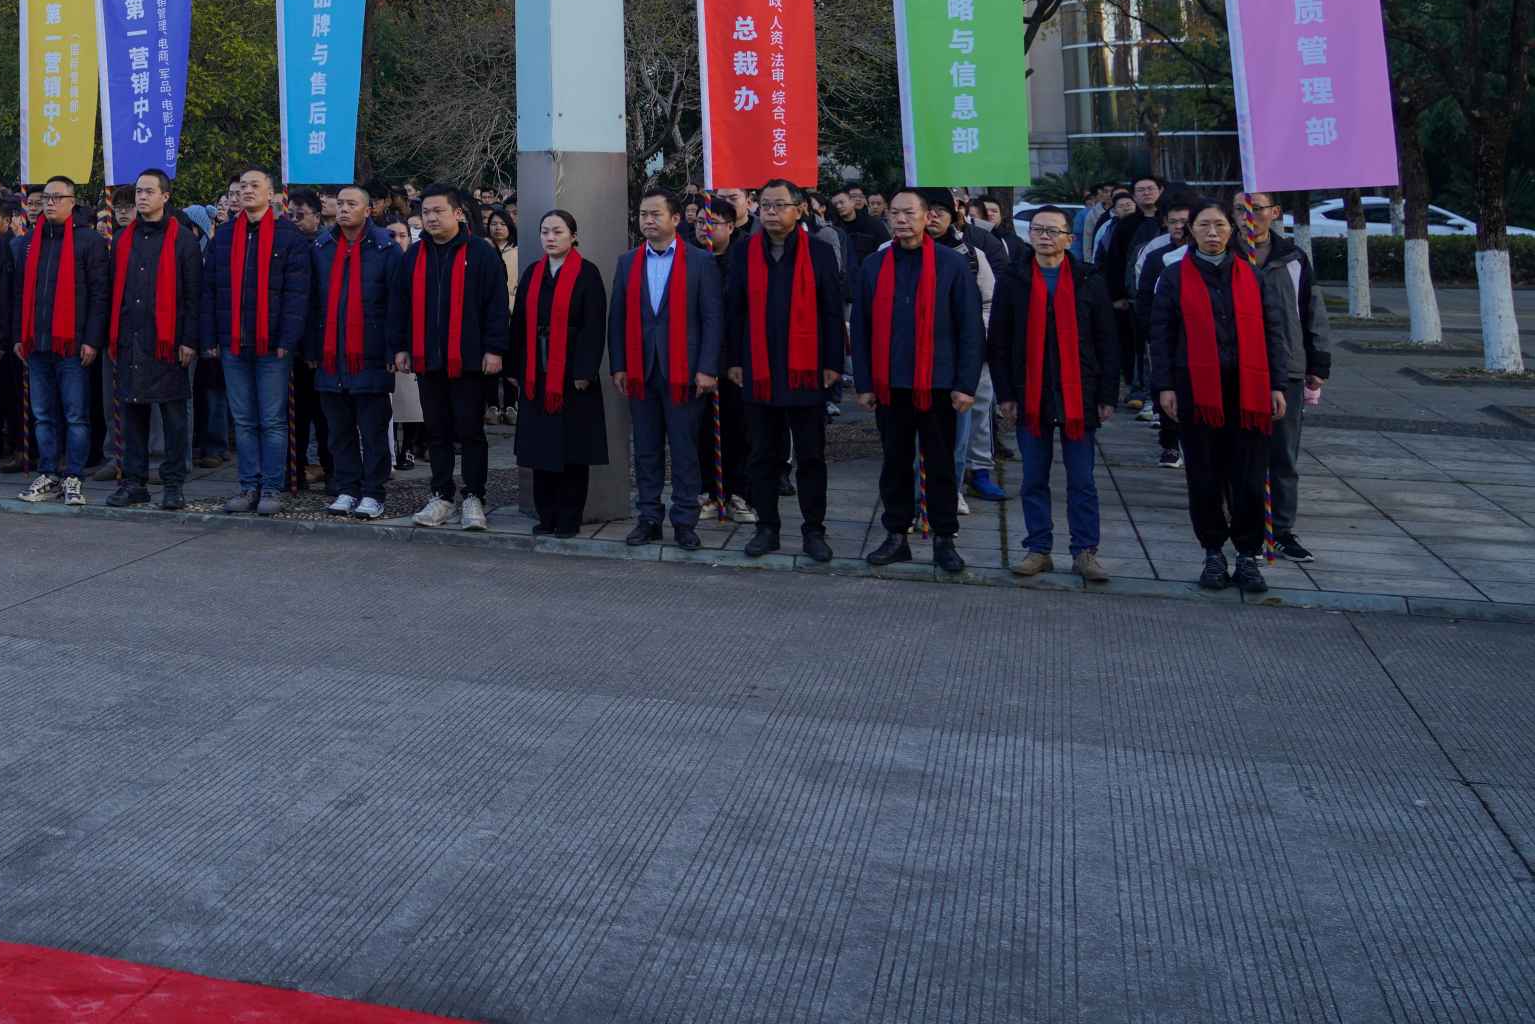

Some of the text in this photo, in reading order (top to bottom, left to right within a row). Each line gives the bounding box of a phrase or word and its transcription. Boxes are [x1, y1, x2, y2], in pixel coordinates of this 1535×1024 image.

[42, 3, 63, 147] 第一营销中心
[732, 16, 760, 111] 总裁办
